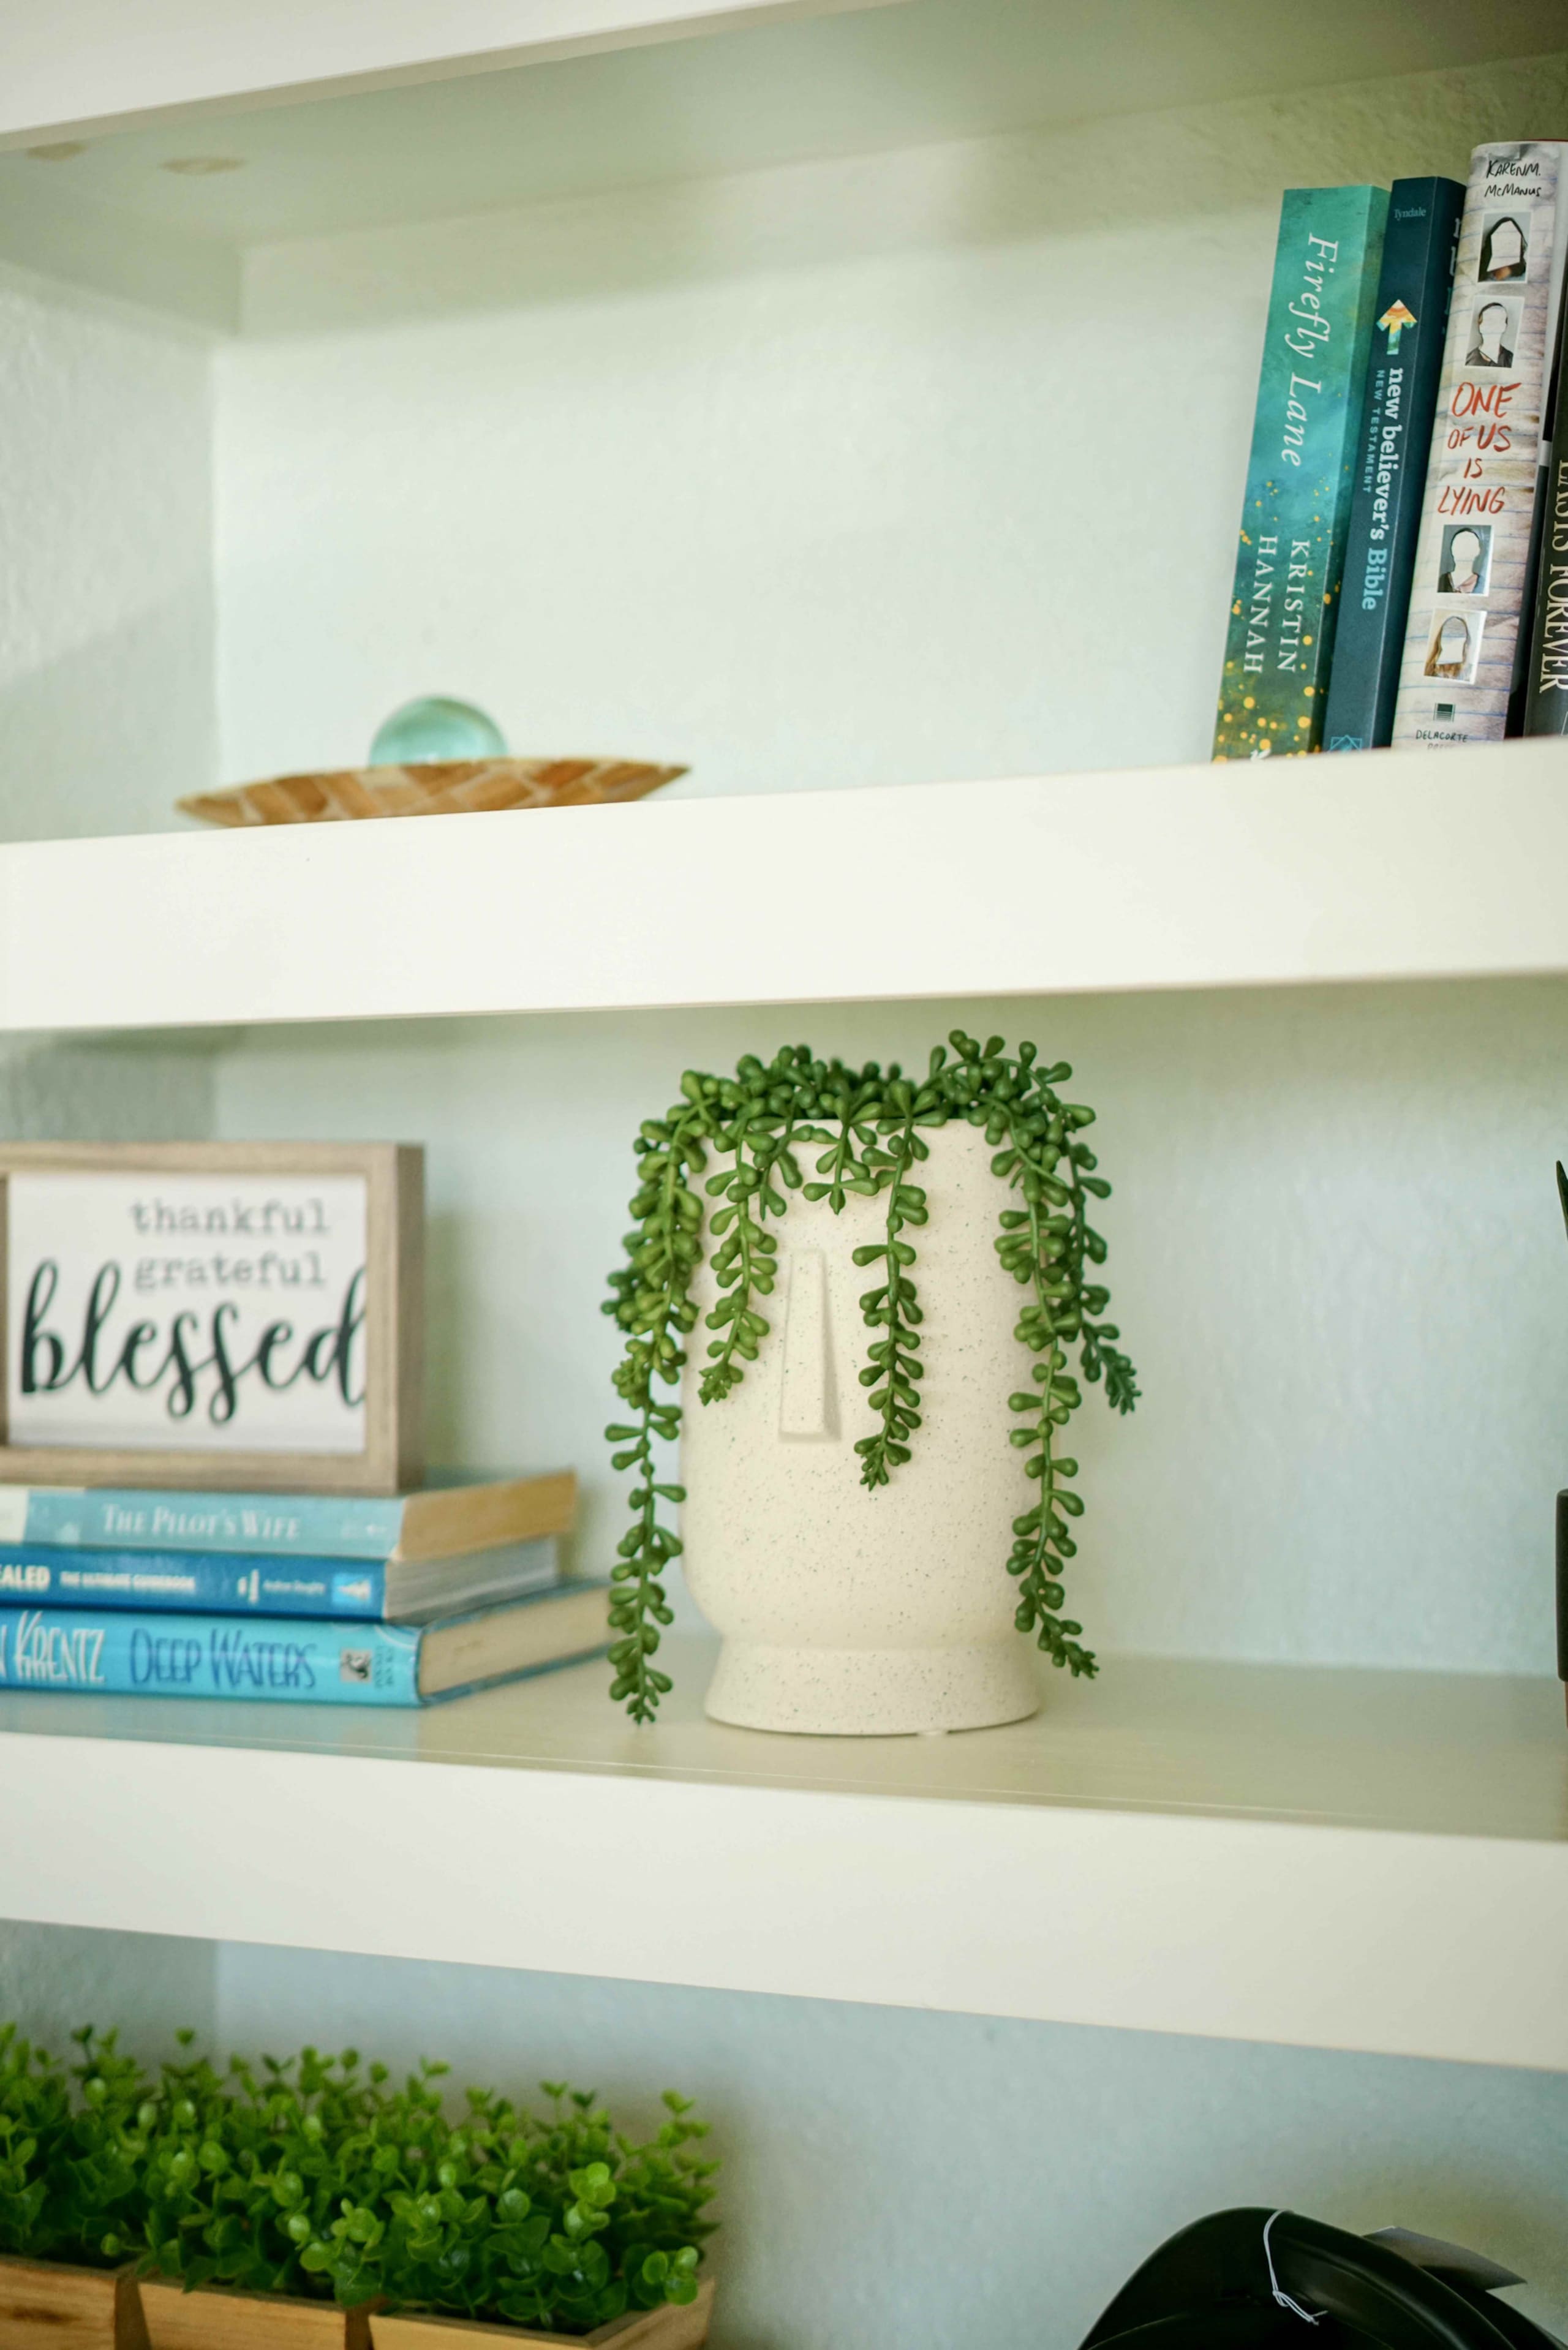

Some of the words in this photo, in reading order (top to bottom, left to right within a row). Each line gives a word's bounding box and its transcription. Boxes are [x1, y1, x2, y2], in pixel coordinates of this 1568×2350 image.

[1486, 160, 1526, 178] KAREN
[1393, 207, 1427, 221] Tyndale
[1284, 232, 1339, 358] Firefly
[1374, 369, 1385, 400] NEW
[1385, 367, 1403, 420] new
[1452, 382, 1522, 418] ONE
[1281, 372, 1322, 467] Lane
[1447, 426, 1474, 449] OF
[1477, 423, 1512, 452] US
[1362, 407, 1381, 493] TESTAMENT
[1463, 458, 1482, 478] IS
[1370, 424, 1403, 541] believer's
[1438, 486, 1505, 516] LYING
[1362, 547, 1388, 611] Bible
[1243, 534, 1278, 673] HANNAH
[1276, 539, 1311, 672] KRISTIN
[1539, 563, 1568, 694] FOREVER
[1415, 729, 1468, 742] DELACORTE
[131, 1199, 328, 1233] thankful
[134, 1252, 325, 1291] grateful
[21, 1258, 366, 1425] blessed
[0, 1564, 51, 1592] ALED
[14, 1610, 105, 1684] KRENTZ
[130, 1627, 202, 1684] DEEP
[209, 1627, 318, 1689] WATERS
